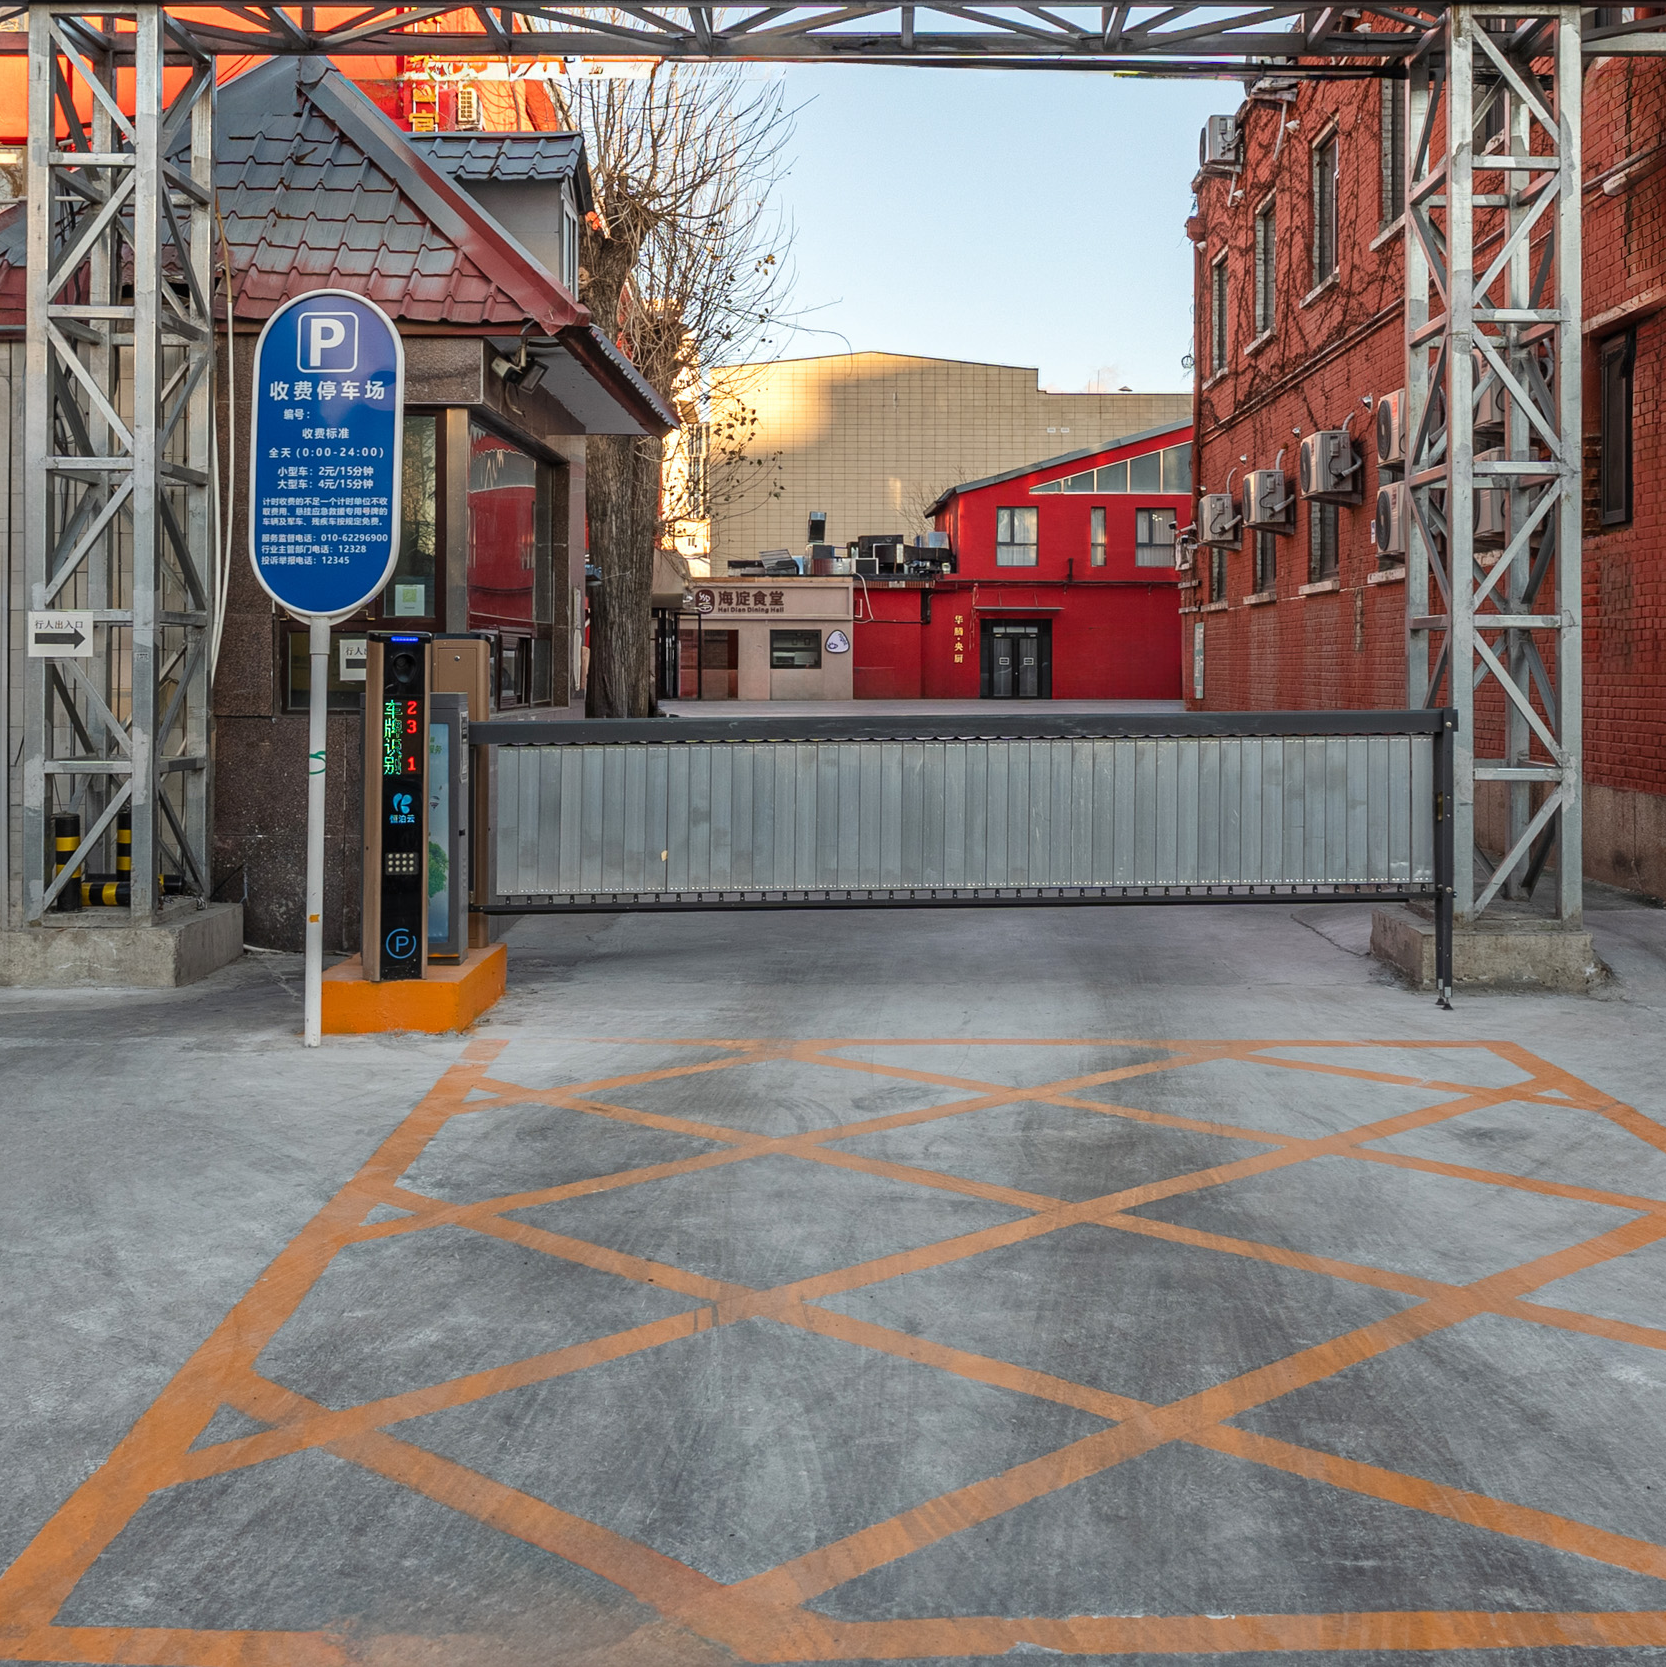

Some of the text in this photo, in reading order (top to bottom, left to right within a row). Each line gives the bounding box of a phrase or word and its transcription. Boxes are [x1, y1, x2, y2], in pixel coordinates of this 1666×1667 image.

[309, 318, 346, 367] P
[269, 380, 385, 401] 收费停车场
[302, 427, 350, 439] 收费标准
[262, 497, 388, 506] 计时收费的不足一个计时单位不收
[718, 590, 784, 607] 海淀食堂
[747, 606, 769, 614] Dining
[34, 620, 83, 629] 行人出入口
[346, 646, 367, 656] 行人
